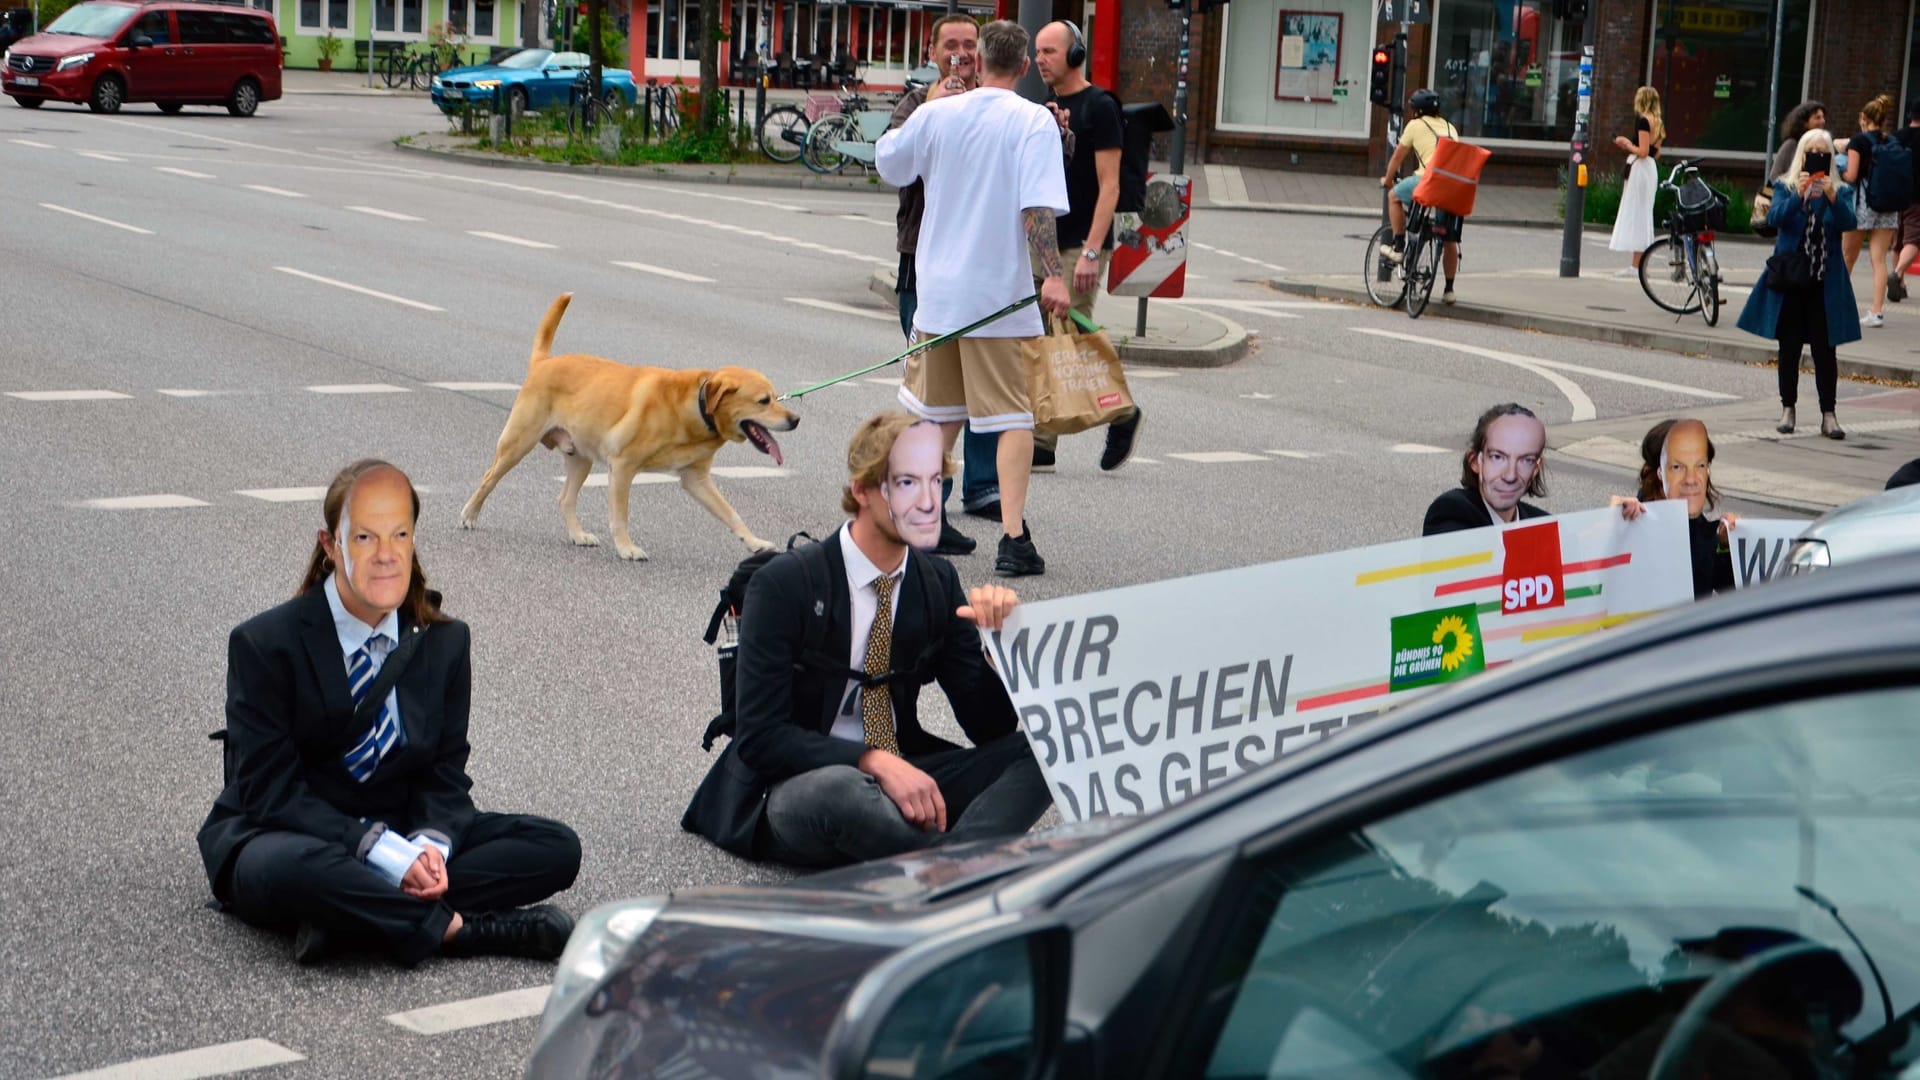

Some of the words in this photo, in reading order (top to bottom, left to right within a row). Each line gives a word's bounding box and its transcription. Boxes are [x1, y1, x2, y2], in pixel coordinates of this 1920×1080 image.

[1738, 538, 1796, 587] W
[1504, 574, 1554, 610] SPD
[991, 615, 1119, 693] WIR
[1393, 664, 1407, 677] DIE
[1409, 657, 1441, 674] GRÜNEN
[1396, 647, 1430, 664] BÜNDNIS
[1432, 645, 1443, 656] 90
[1019, 654, 1294, 768] BRECHEN
